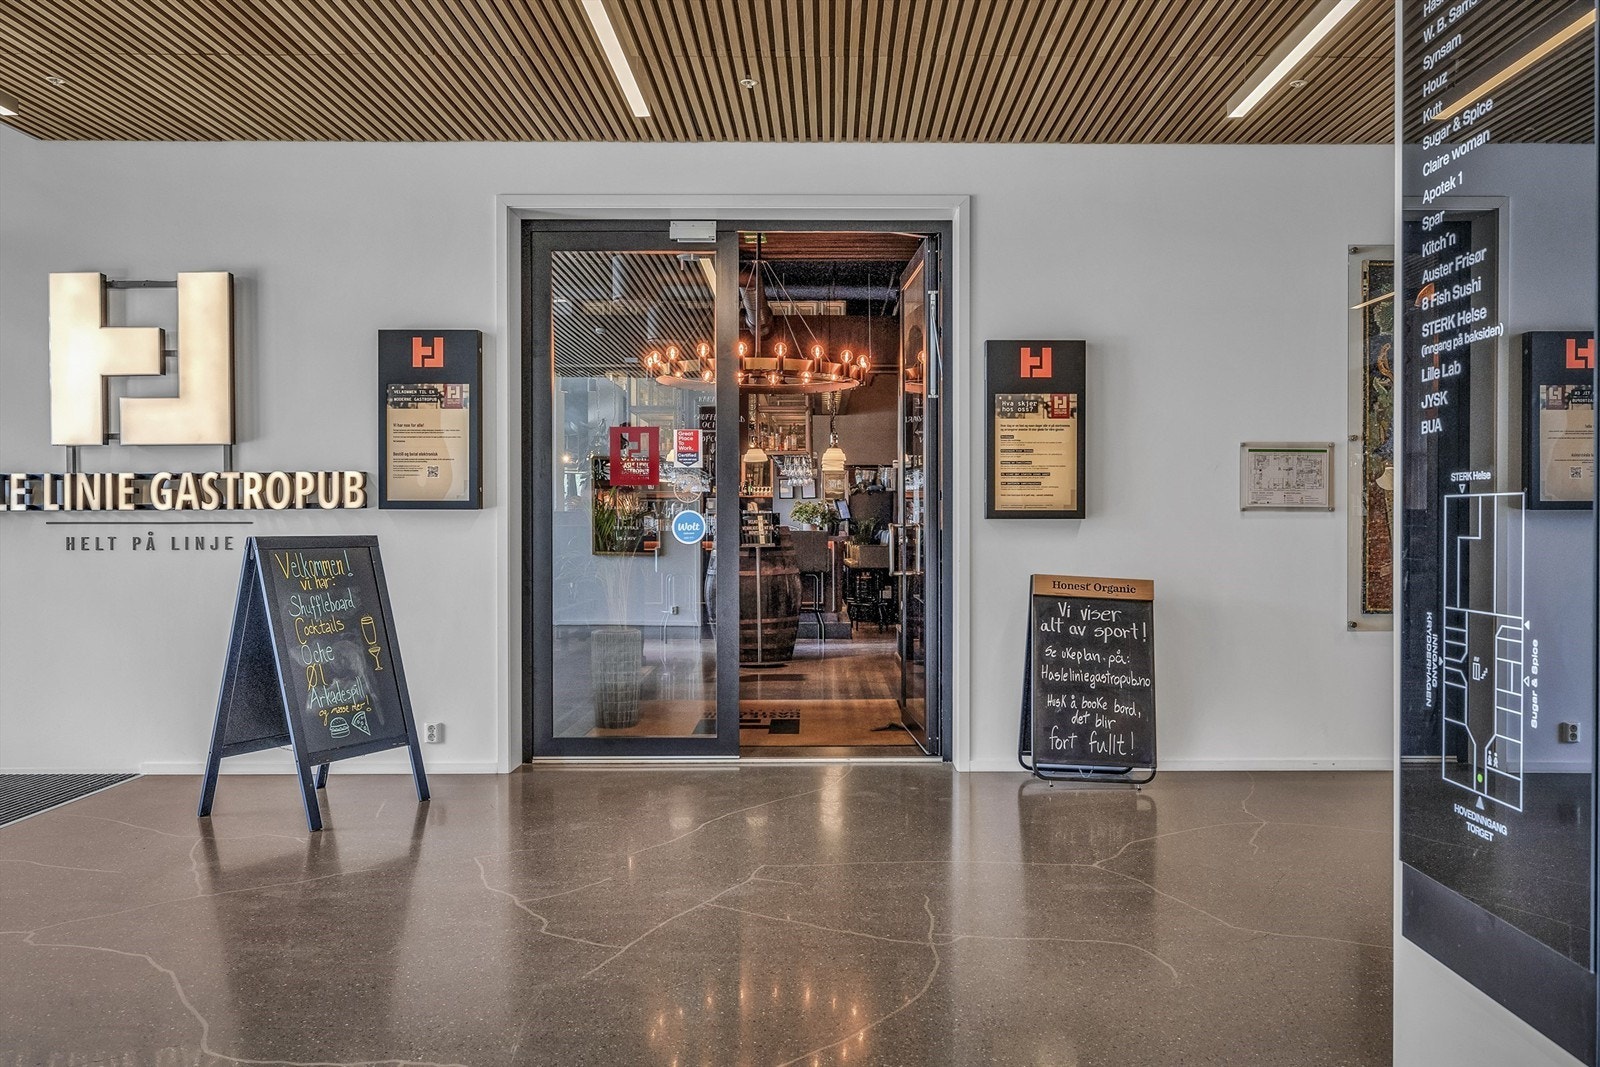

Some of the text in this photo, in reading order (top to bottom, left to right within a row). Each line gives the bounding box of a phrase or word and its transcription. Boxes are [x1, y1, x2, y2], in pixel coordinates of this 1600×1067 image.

[1423, 24, 1435, 43] W.
[1437, 17, 1447, 34] B.
[1423, 34, 1462, 70] Synsam
[1423, 72, 1448, 97] Houz
[1422, 98, 1494, 150] Sugar & Spice
[1423, 100, 1443, 124] Kutt
[1422, 130, 1491, 177] Claire woman
[1422, 170, 1463, 205] Apotek 1
[1422, 210, 1446, 232] Spar
[1422, 248, 1488, 285] Auster Frisør
[1422, 276, 1482, 311] 8 Fish Sushi
[1422, 306, 1488, 338] STERK Helse
[1422, 322, 1504, 358] (inngang på baksiden)
[1421, 360, 1462, 382] Lille Lab
[1421, 390, 1449, 409] JYSK
[1421, 418, 1443, 435] BUA
[1450, 470, 1492, 482] STERK Helse
[44, 472, 136, 511] LINIE
[150, 470, 367, 511] GASTROPUB
[678, 522, 700, 531] Wolt
[66, 531, 235, 551] HELT PÅ LINJE
[274, 550, 354, 579] Velkommen!
[1052, 580, 1136, 594] Honest Organic
[288, 588, 356, 620] Shuffleboard
[1058, 602, 1122, 622] Vi viser
[294, 615, 345, 644] Cocktails
[1040, 617, 1064, 633] alt
[1069, 625, 1086, 636] av
[301, 642, 334, 664] Oche
[1045, 646, 1057, 658] Se
[306, 663, 328, 691] Øl
[1531, 639, 1539, 729] Sugar & Spice
[309, 676, 365, 709] Arkadespill
[319, 710, 329, 726] og
[1070, 694, 1078, 709] å
[1114, 698, 1141, 718] bord,
[1071, 710, 1117, 729] det blir
[1049, 725, 1078, 750] fort
[1454, 803, 1508, 836] HOVEDINNGANG
[1466, 821, 1494, 841] TORGET
